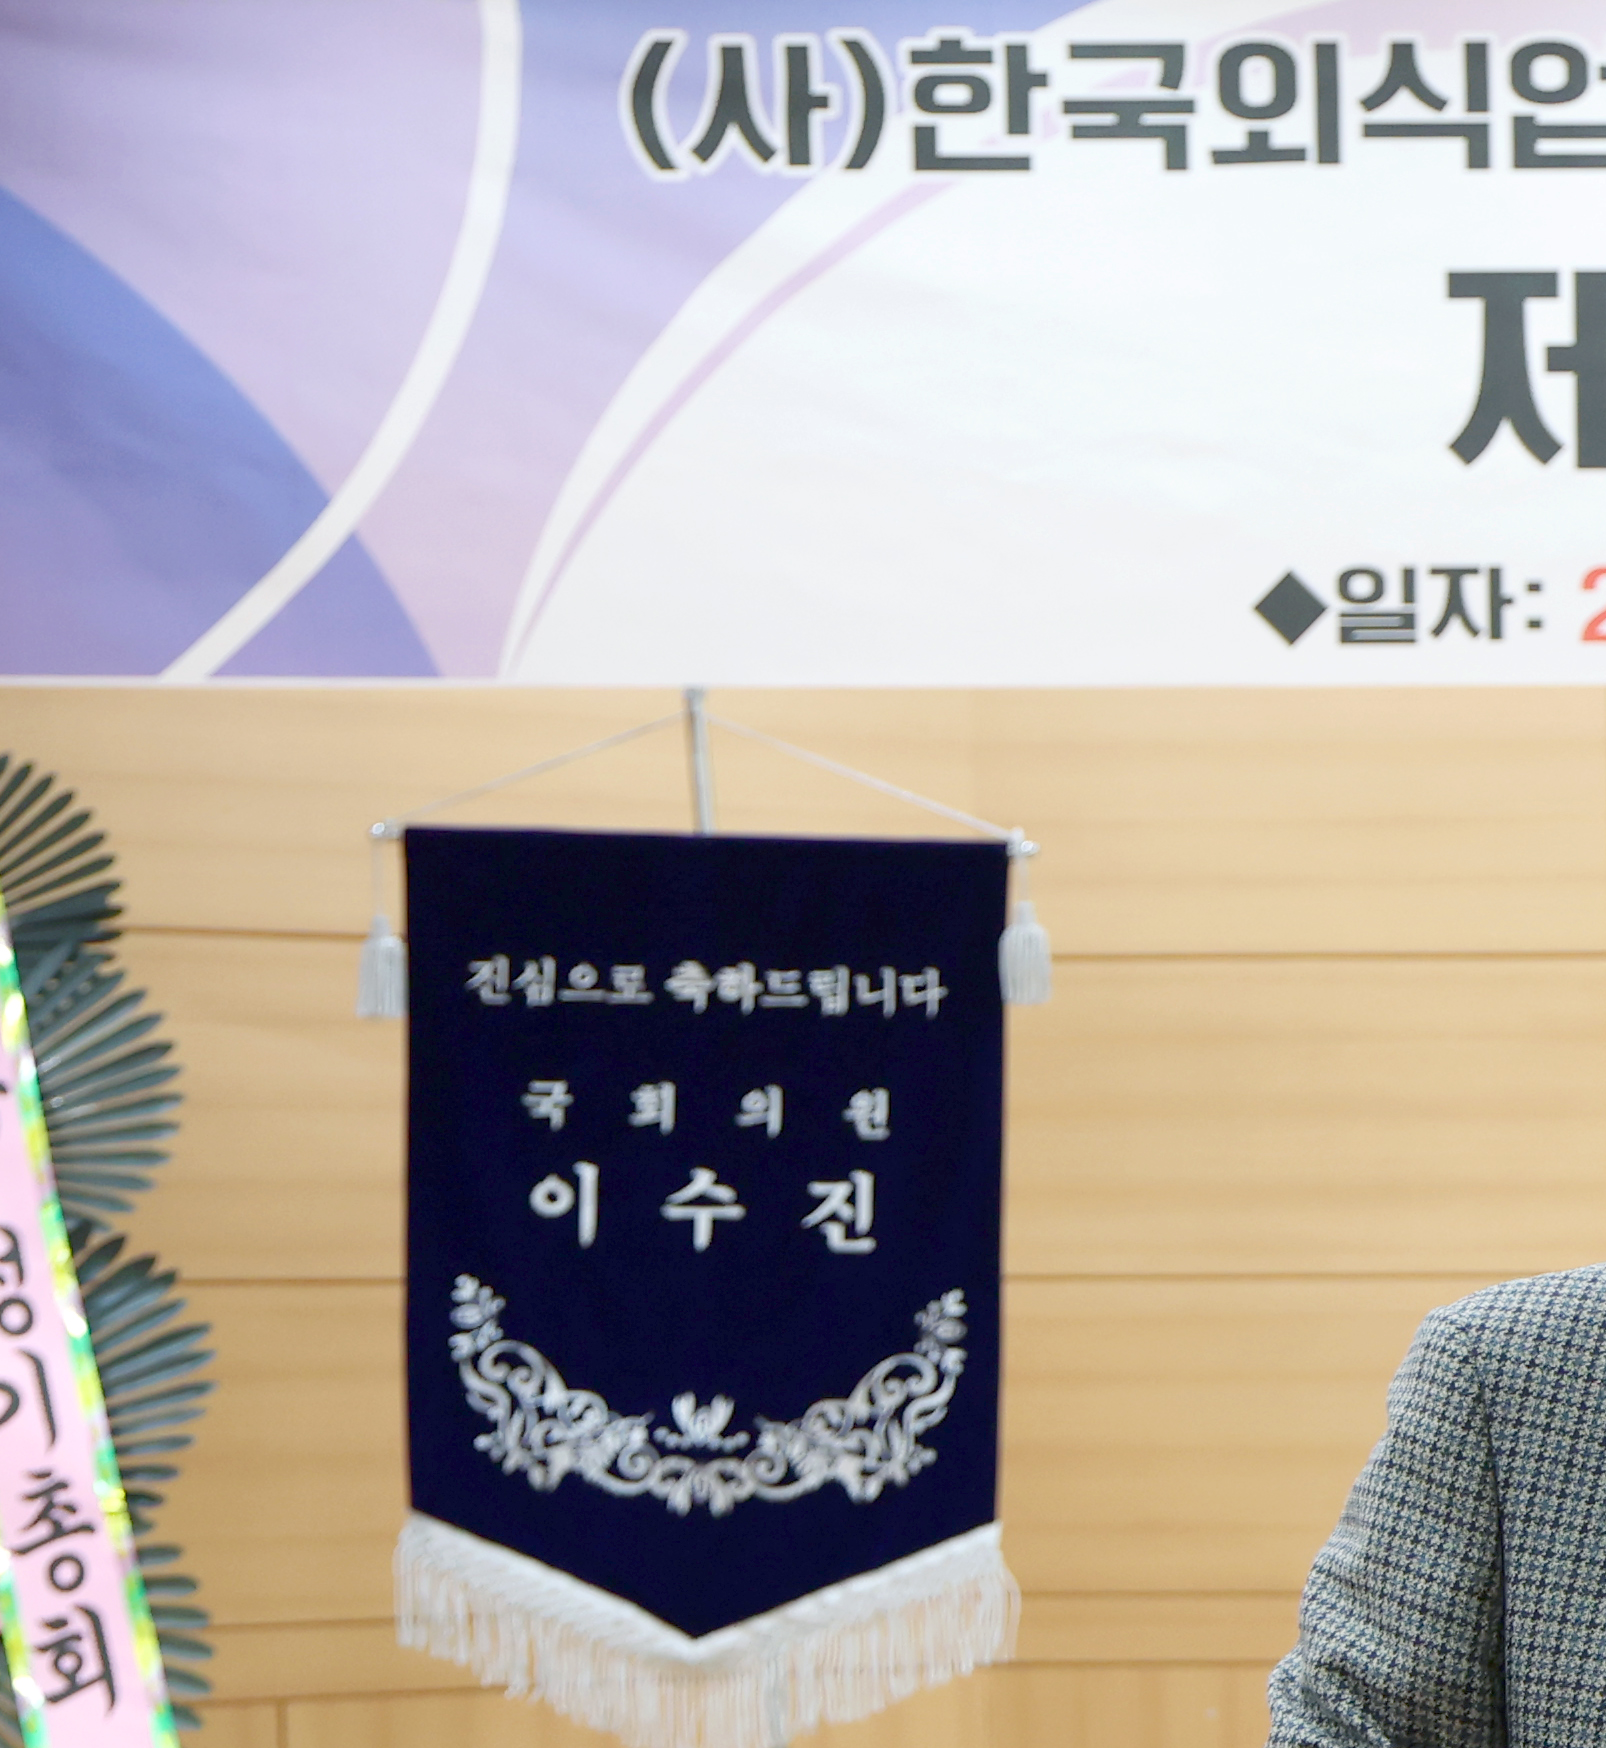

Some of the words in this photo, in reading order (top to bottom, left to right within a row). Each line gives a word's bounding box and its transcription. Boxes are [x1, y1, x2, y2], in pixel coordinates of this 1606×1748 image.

[1335, 565, 1545, 645] 일자:
[465, 953, 654, 1007] 진심으로
[664, 959, 948, 1019] 축하드립니다
